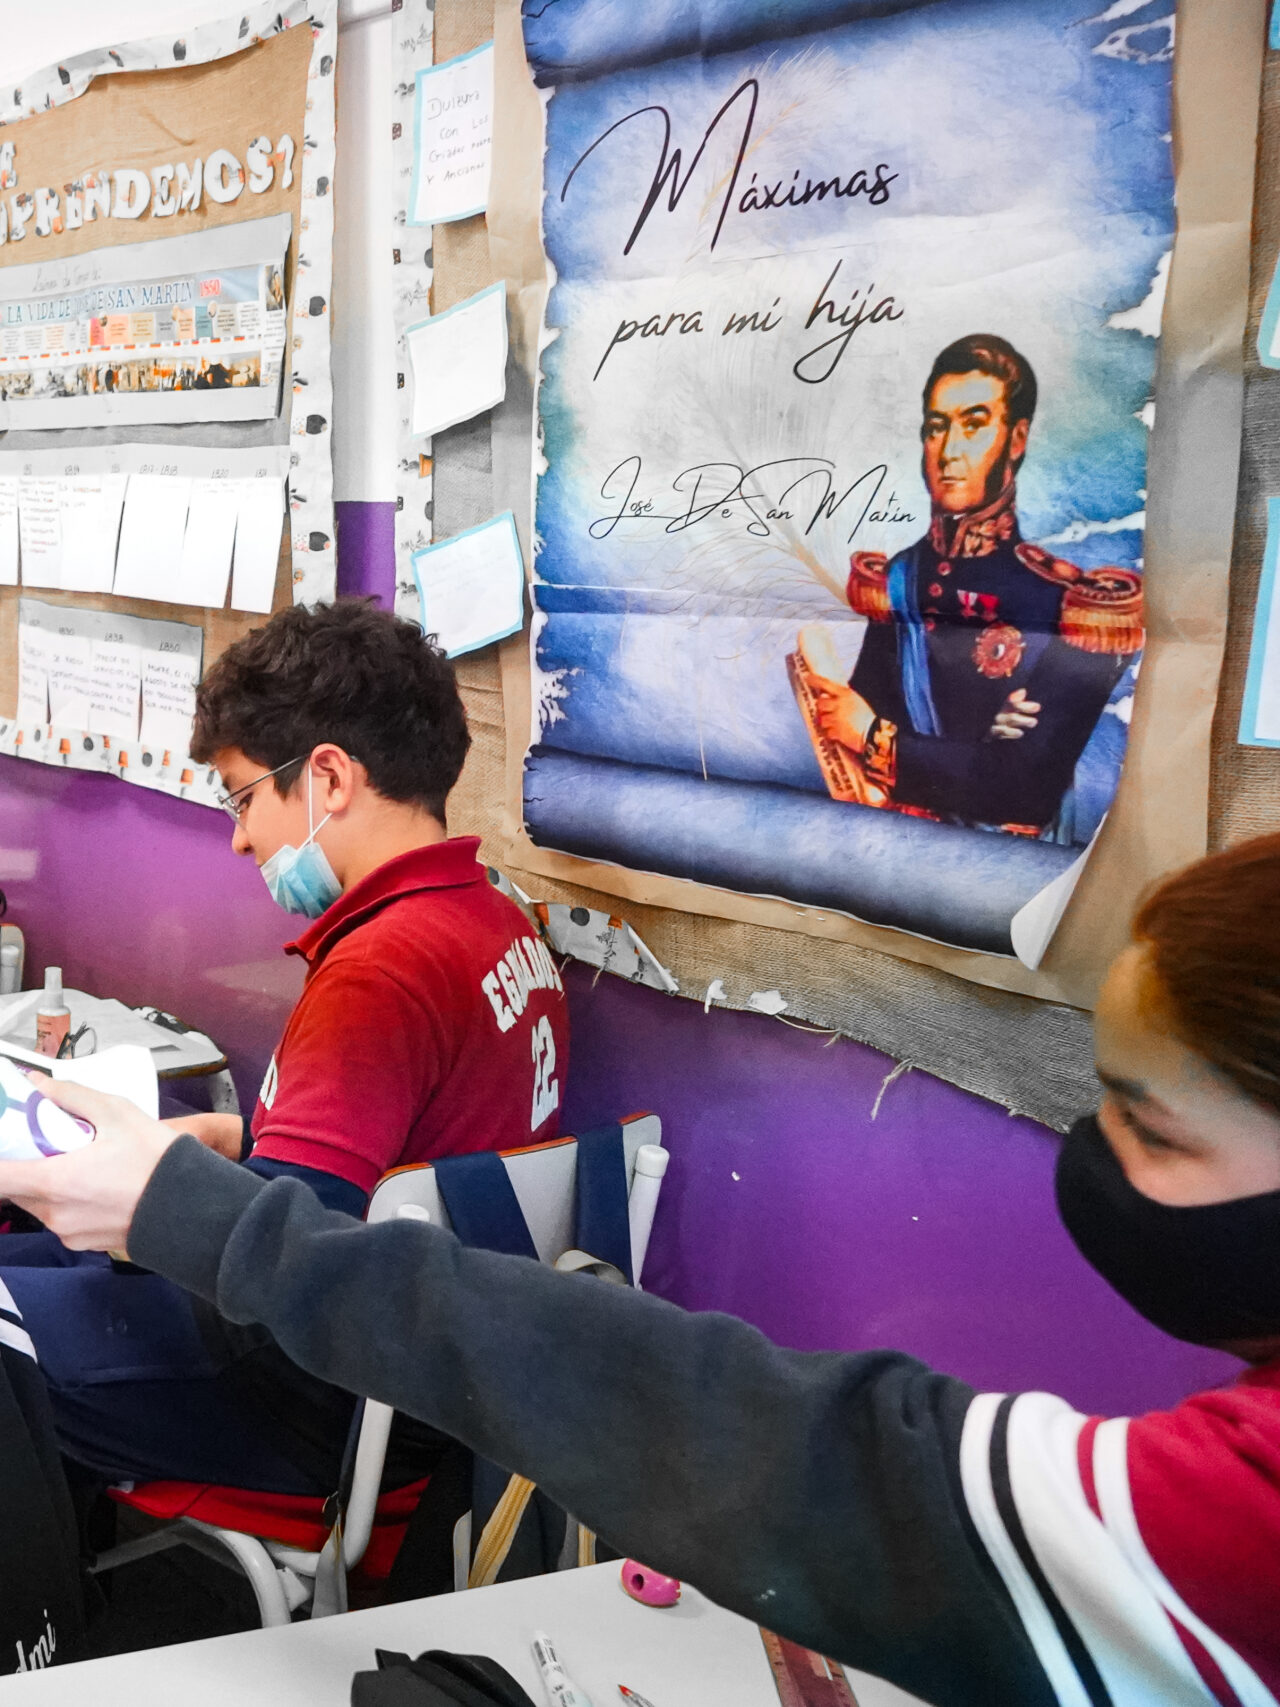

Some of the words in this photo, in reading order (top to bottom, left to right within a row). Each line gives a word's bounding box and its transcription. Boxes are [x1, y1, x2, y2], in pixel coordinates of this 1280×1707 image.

[561, 78, 899, 257] Máximas
[7, 303, 23, 323] LA
[26, 300, 56, 321] VIDA
[58, 298, 71, 319] DE
[107, 286, 136, 310] SAN
[593, 309, 704, 382] para
[792, 258, 907, 384] hija
[588, 456, 682, 539] José
[739, 457, 837, 537] San
